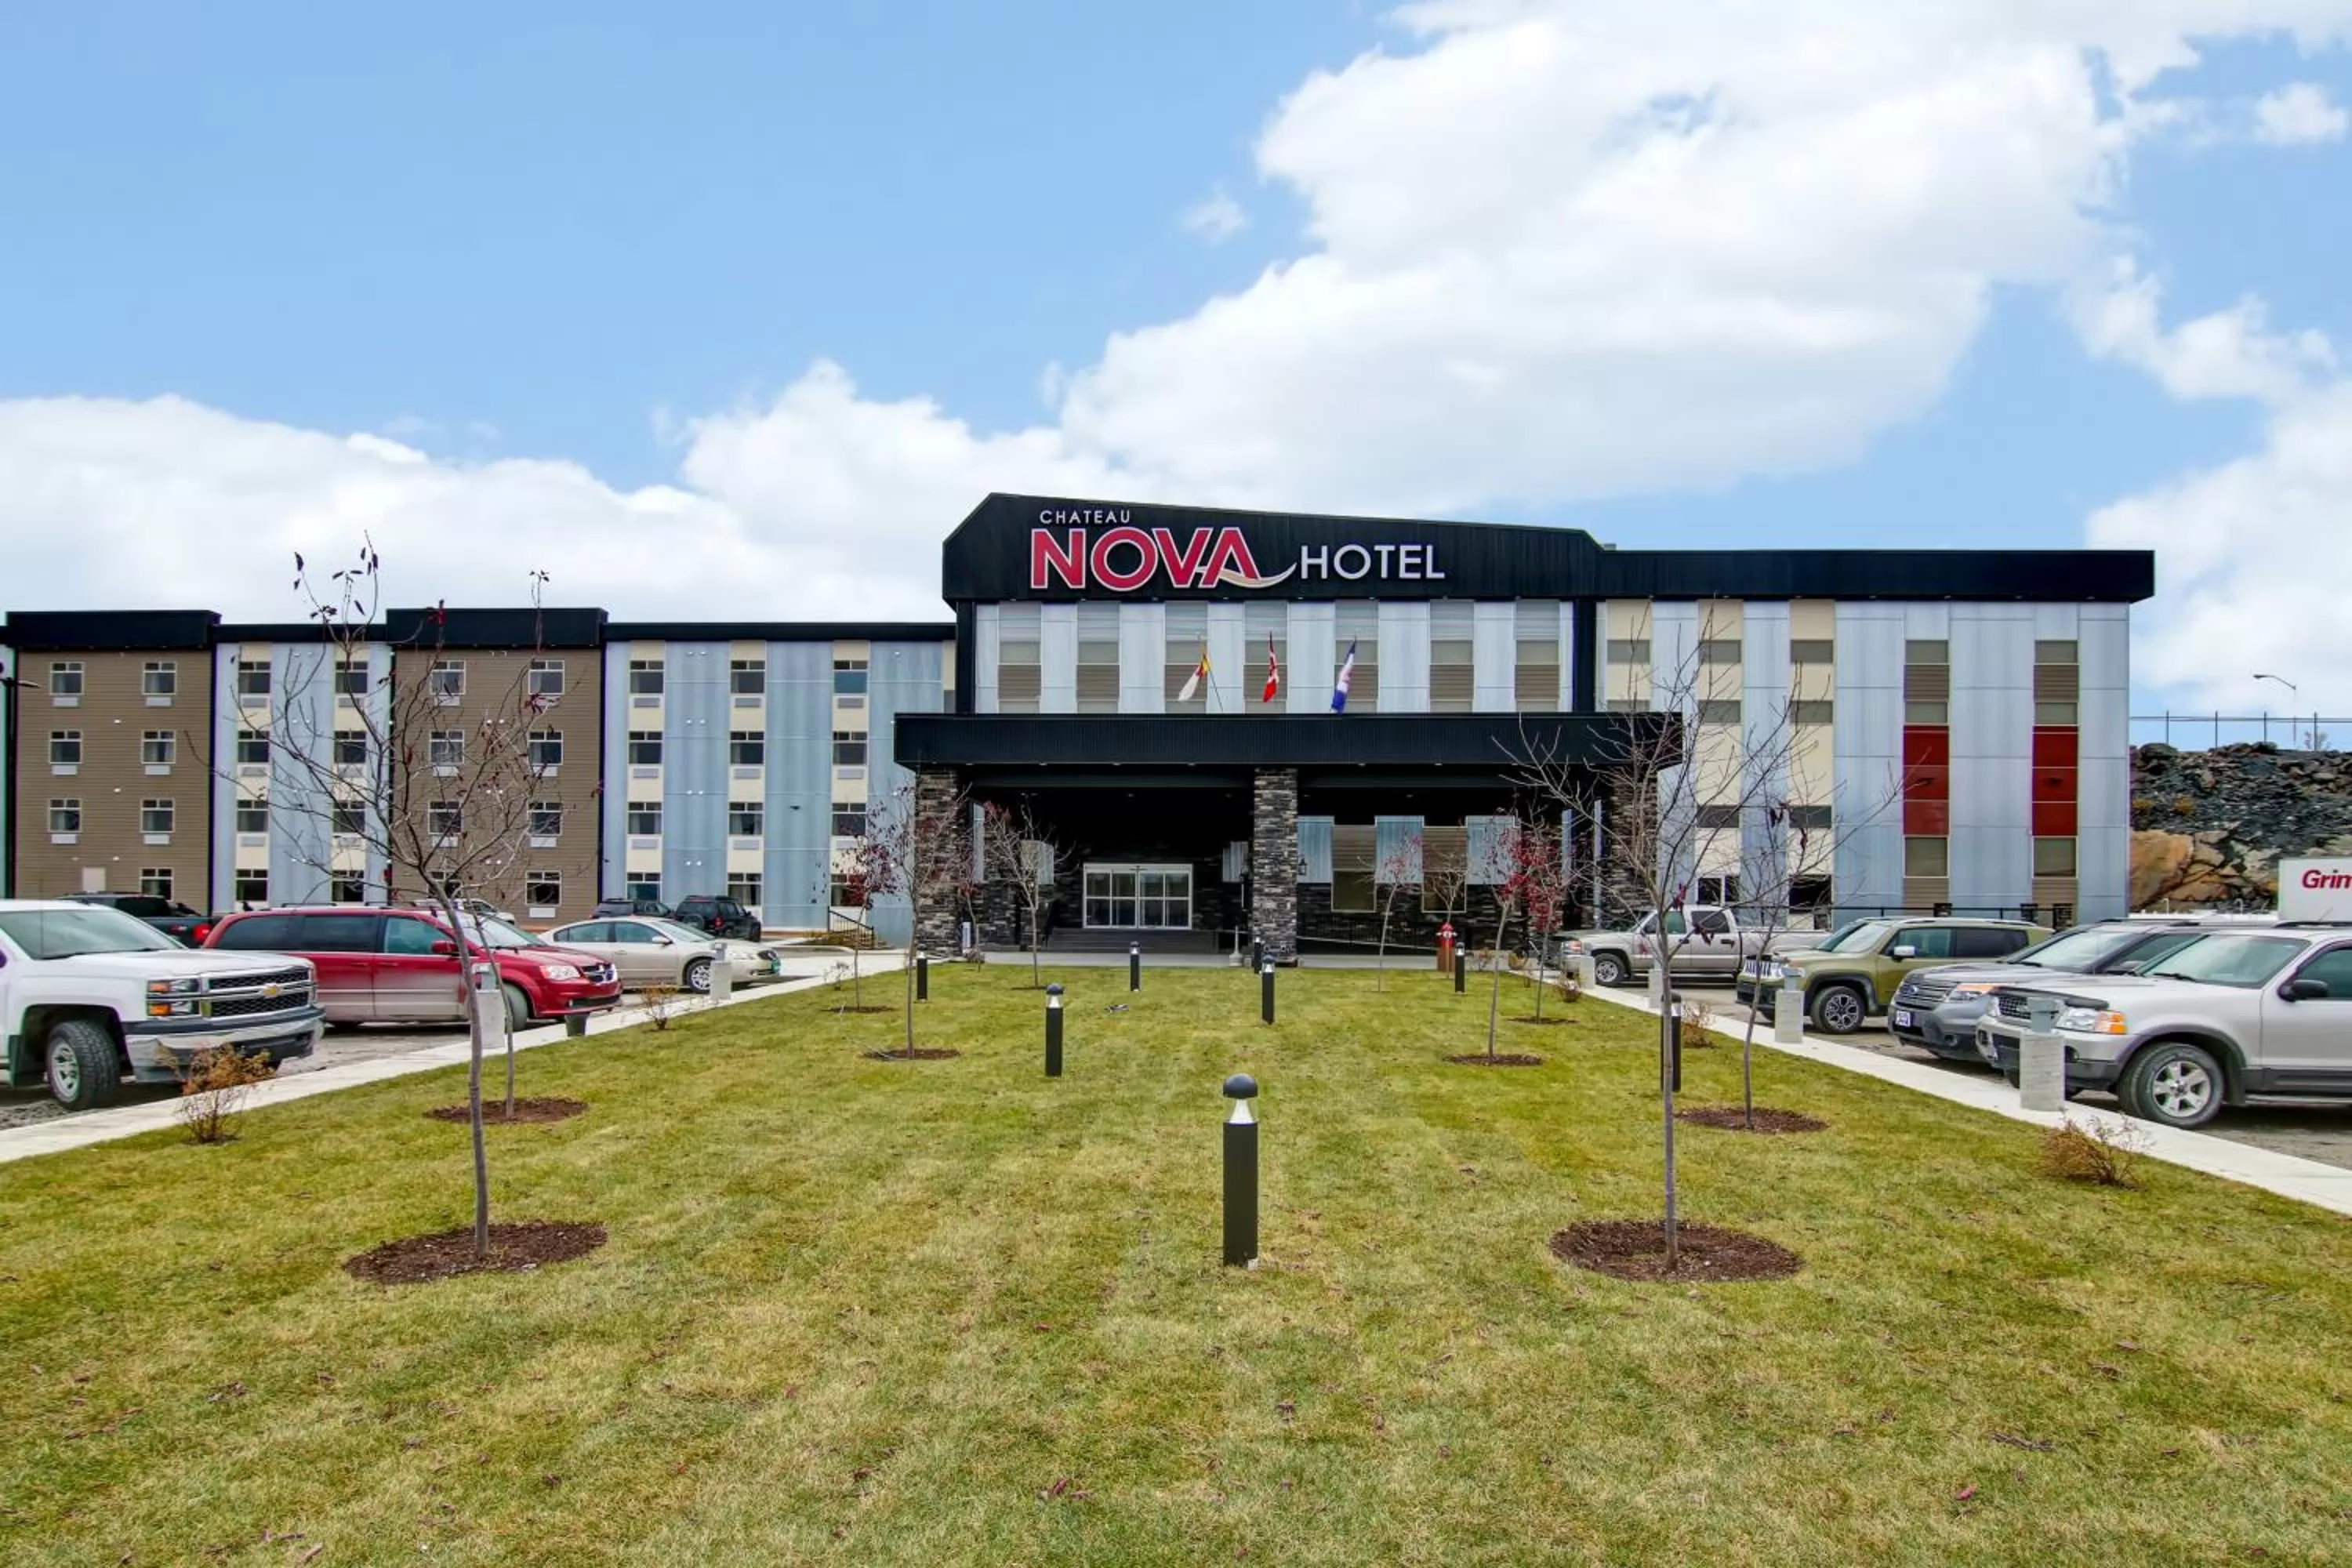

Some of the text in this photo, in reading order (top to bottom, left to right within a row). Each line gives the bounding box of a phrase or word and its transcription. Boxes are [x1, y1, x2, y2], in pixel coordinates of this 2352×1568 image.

[1039, 510, 1131, 524] CHATEAU
[1031, 527, 1446, 591] NOVA HOTEL
